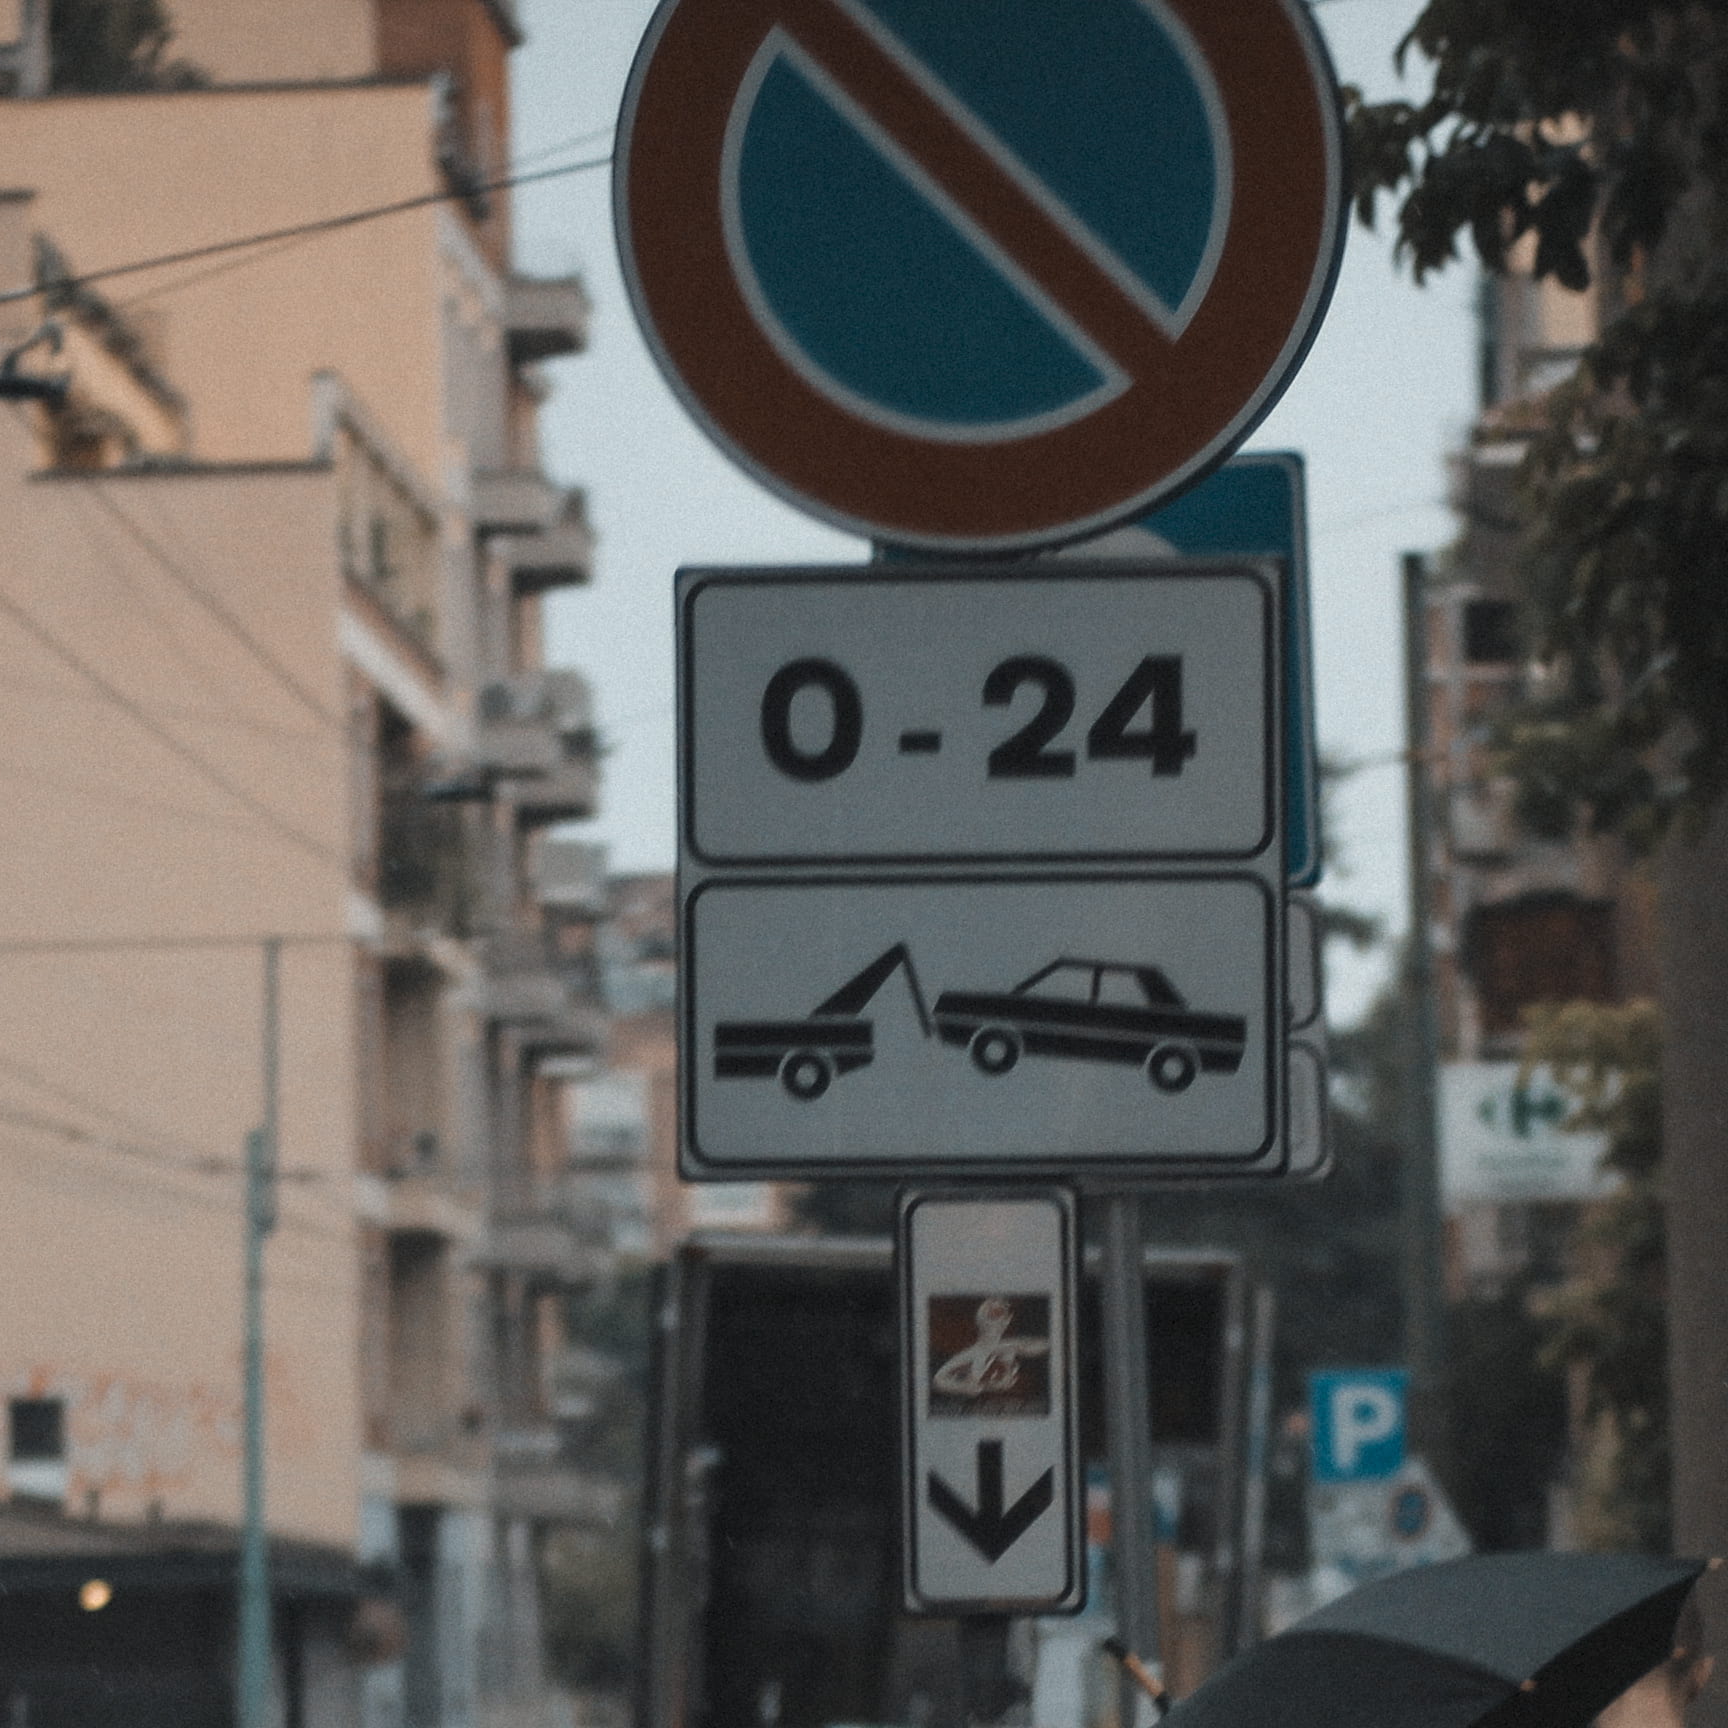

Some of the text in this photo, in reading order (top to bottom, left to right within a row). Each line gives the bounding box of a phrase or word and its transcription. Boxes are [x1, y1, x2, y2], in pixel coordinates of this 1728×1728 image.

[761, 656, 863, 783] 0
[982, 654, 1197, 779] 24
[1331, 1383, 1398, 1469] P
